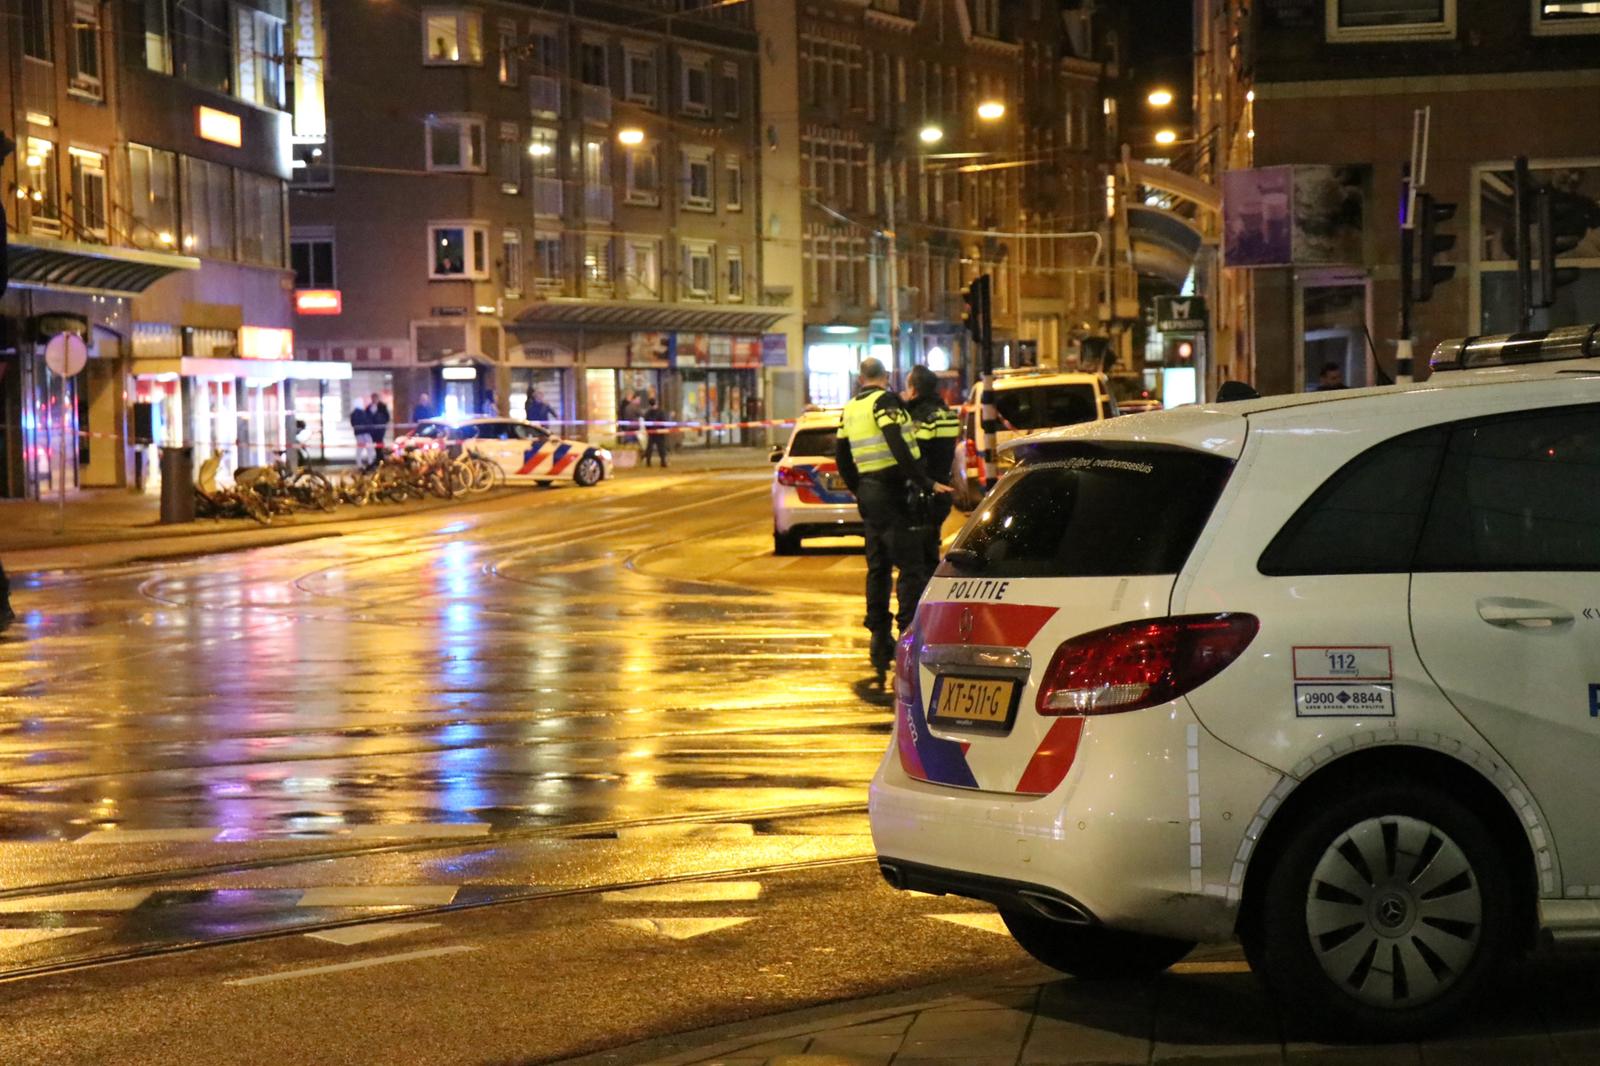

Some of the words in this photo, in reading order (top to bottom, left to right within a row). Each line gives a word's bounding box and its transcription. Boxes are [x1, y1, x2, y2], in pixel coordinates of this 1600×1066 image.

[946, 580, 1009, 600] POLITIE
[1304, 692, 1335, 704] 0900
[1352, 692, 1383, 703] 8844
